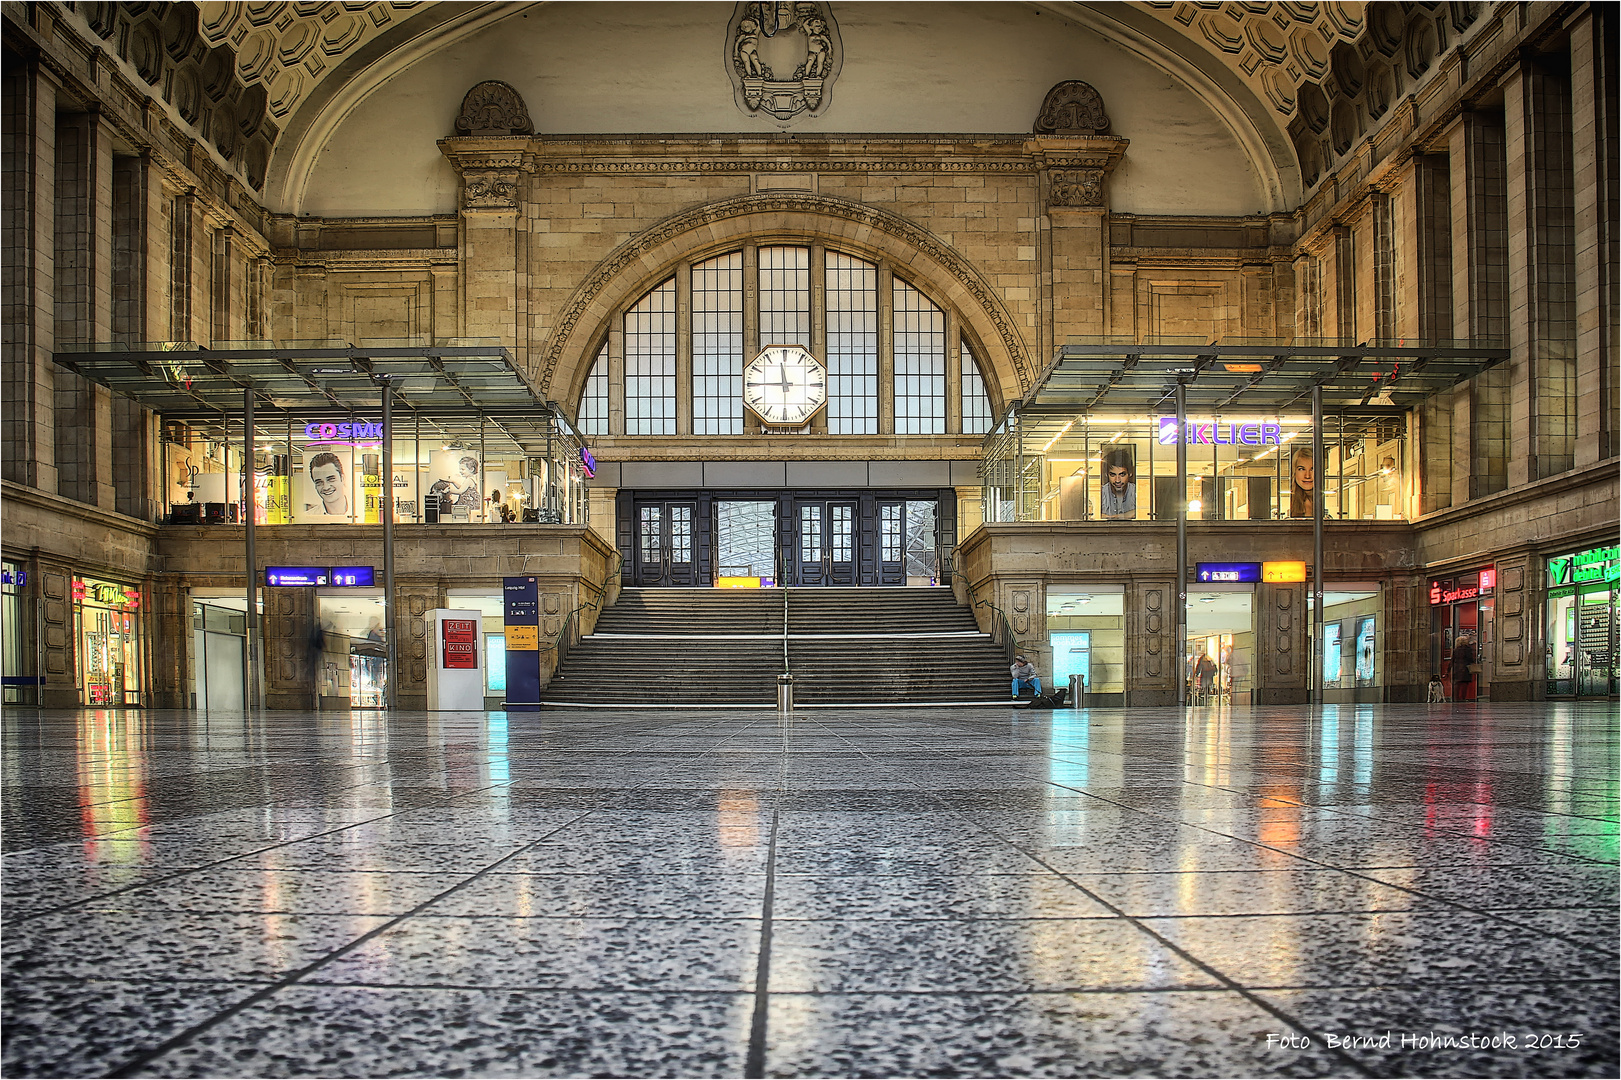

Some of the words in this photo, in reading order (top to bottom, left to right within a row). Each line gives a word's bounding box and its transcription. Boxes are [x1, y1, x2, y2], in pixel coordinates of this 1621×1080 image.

[1191, 422, 1281, 445] KLIER
[1443, 588, 1478, 604] Sparkasse
[449, 622, 470, 630] ZEIT
[449, 644, 471, 652] KINO
